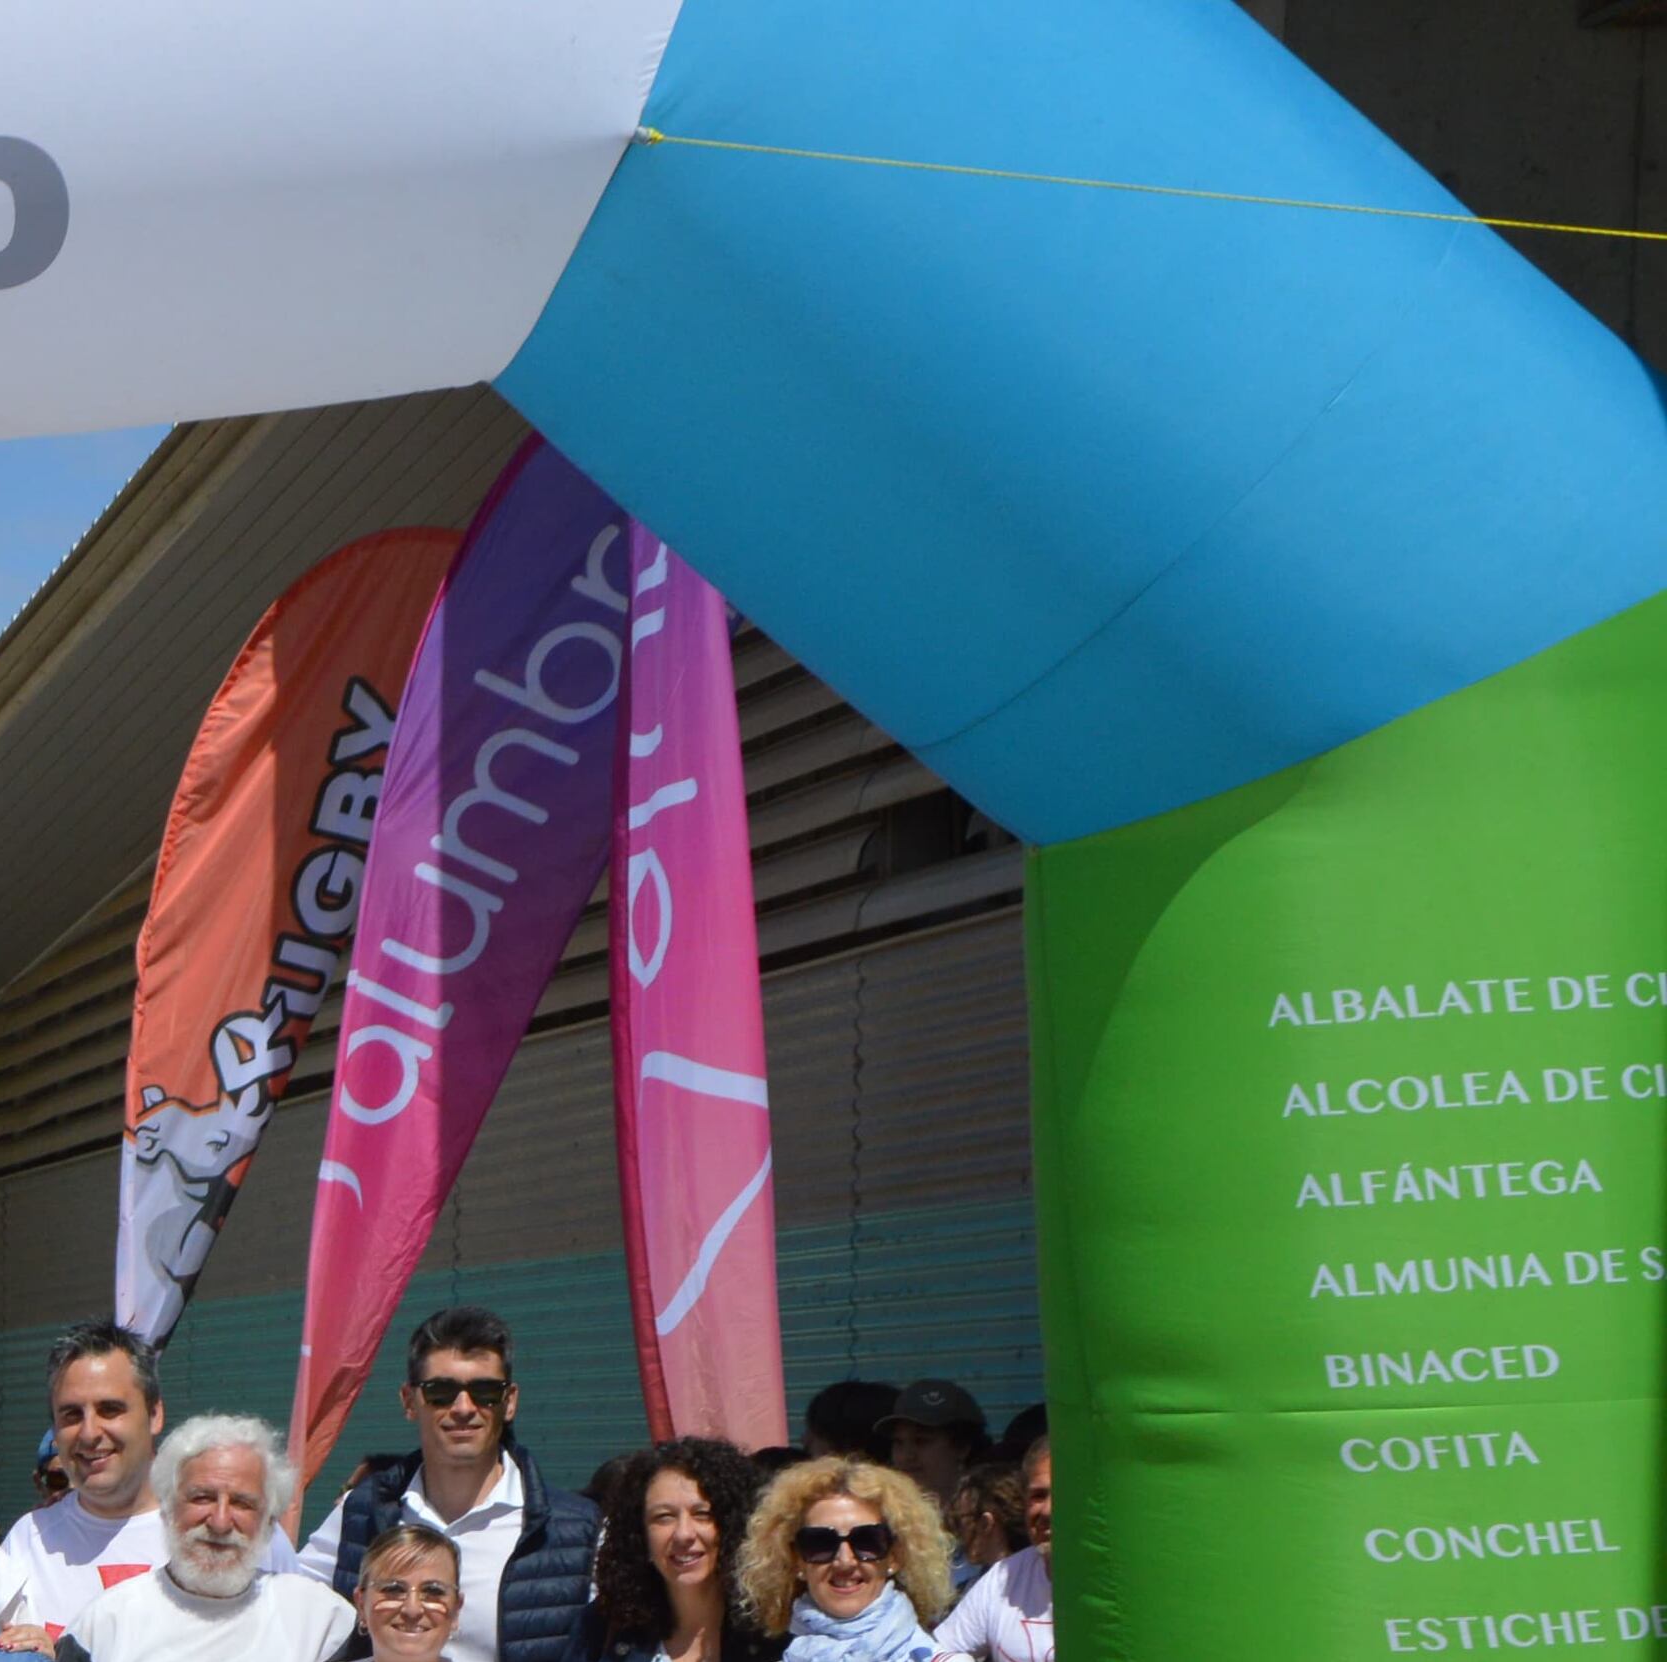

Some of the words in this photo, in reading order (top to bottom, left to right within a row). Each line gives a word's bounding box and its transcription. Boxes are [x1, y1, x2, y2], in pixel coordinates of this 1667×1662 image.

[1268, 977, 1535, 1027] ALBALATE
[1547, 974, 1613, 1011] DE
[1282, 1069, 1531, 1118] ALCOLEA
[1542, 1066, 1609, 1103] DE
[1295, 1159, 1603, 1209] ALFÁNTEGA
[1309, 1252, 1553, 1299] ALMUNIA
[1563, 1249, 1628, 1286] DE
[1639, 1246, 1667, 1282] S
[1323, 1344, 1560, 1389] BINACED
[1339, 1431, 1540, 1473] COFITA
[1364, 1518, 1620, 1563] CONCHEL
[1384, 1609, 1606, 1652] ESTICHE
